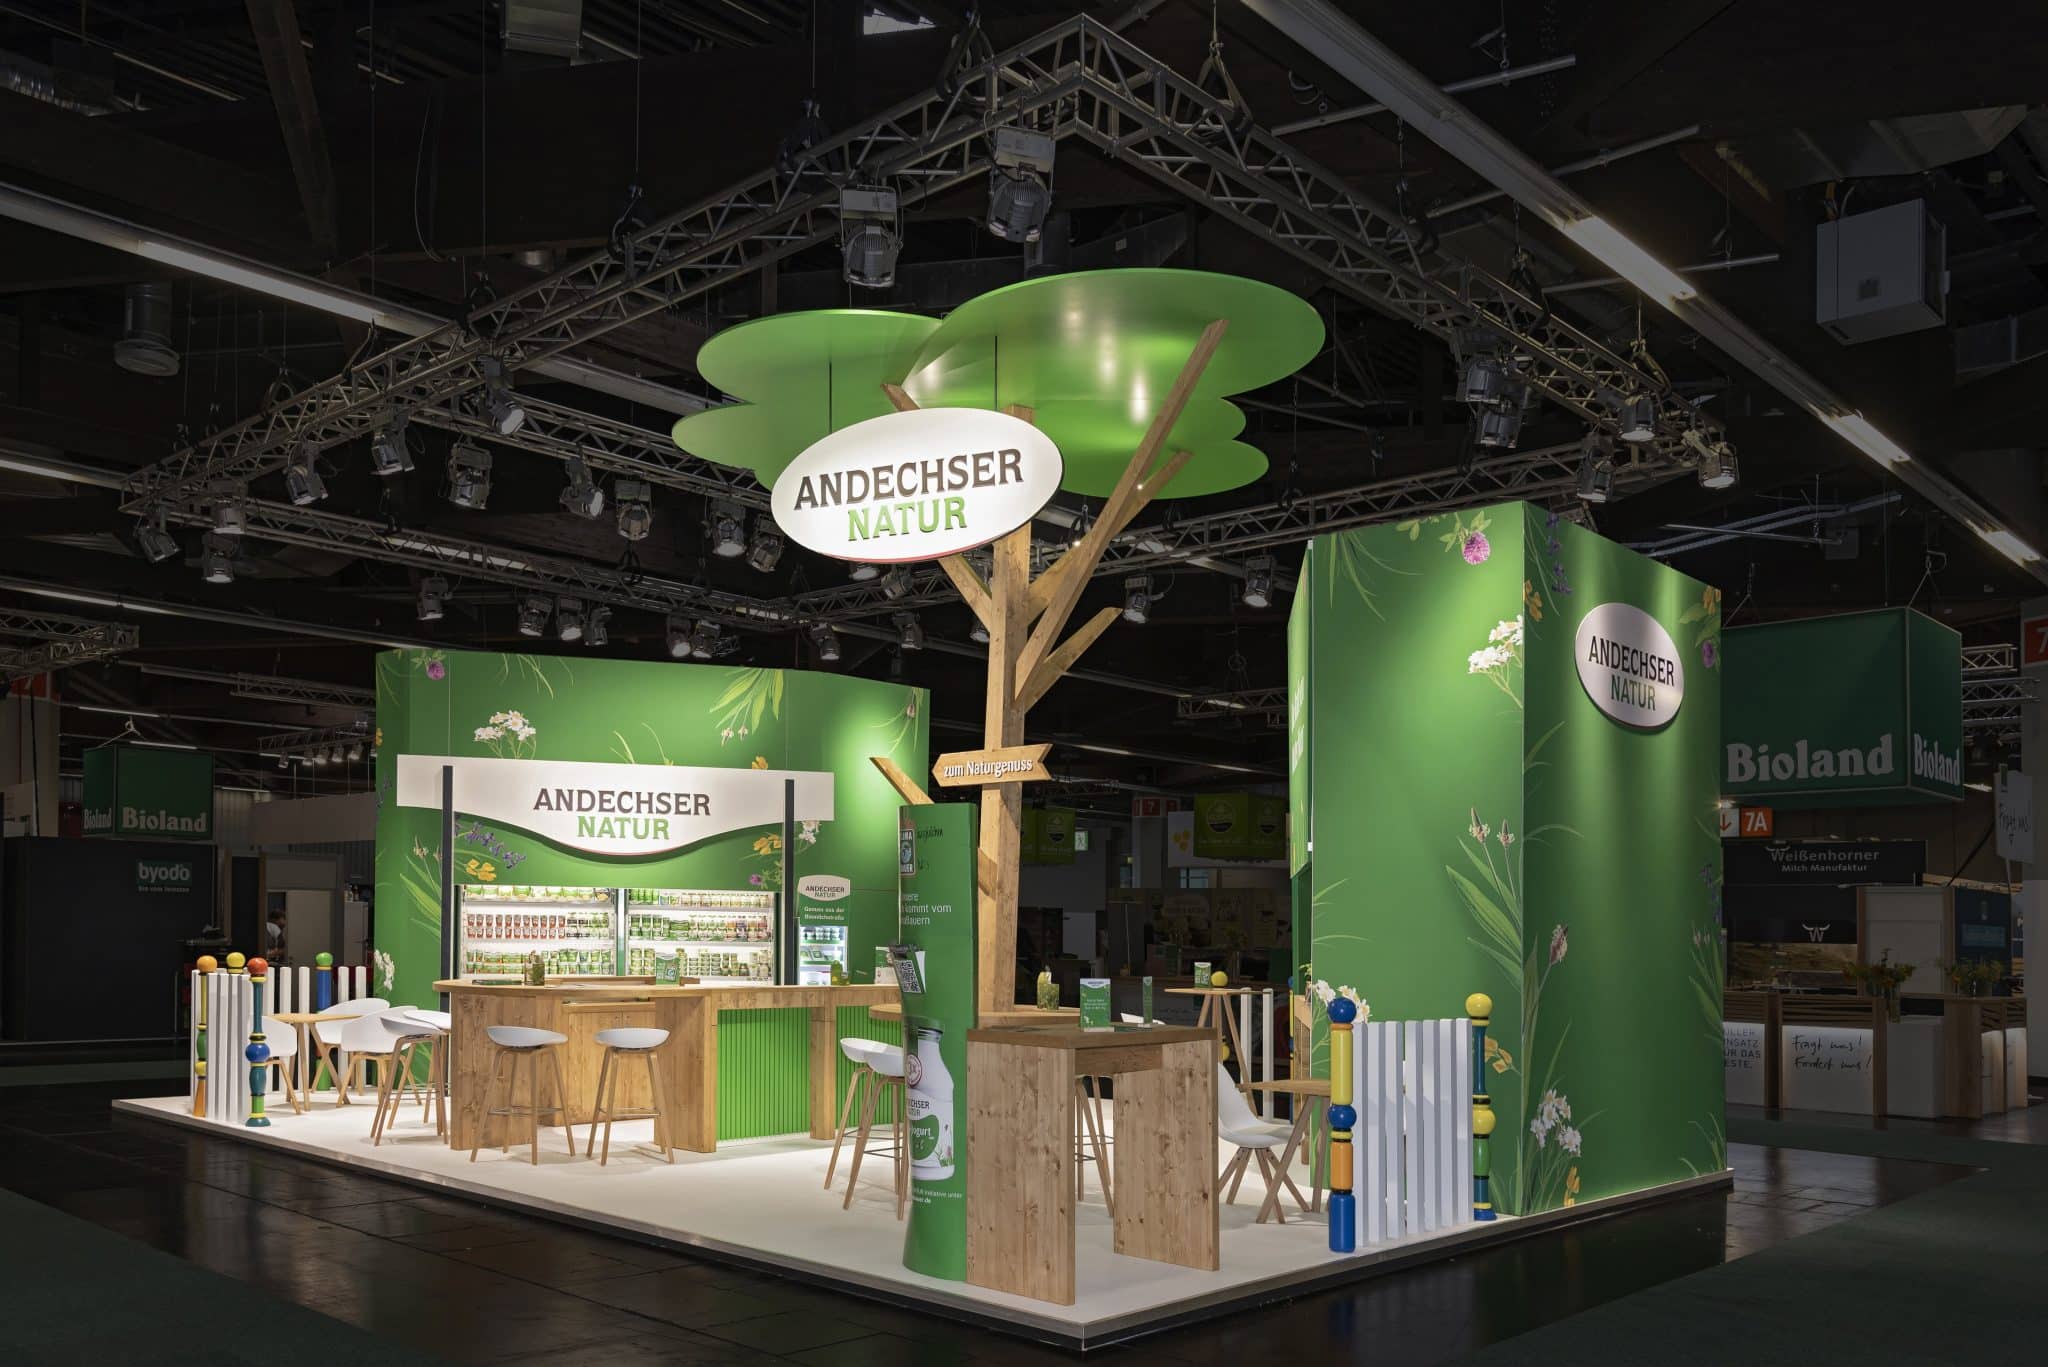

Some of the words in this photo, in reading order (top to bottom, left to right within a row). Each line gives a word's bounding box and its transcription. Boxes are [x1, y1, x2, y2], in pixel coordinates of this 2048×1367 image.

[794, 449, 1024, 510] ANDECHSER
[848, 497, 967, 542] NATUR
[1589, 636, 1674, 686] ANDECHSER
[1611, 675, 1656, 711] NATUR
[944, 765, 964, 777] zum
[967, 760, 1033, 778] Naturgenuss
[1726, 733, 1894, 783] Bioland
[1914, 733, 1960, 786] Bioland
[533, 788, 711, 816] ANDECHSER
[83, 807, 113, 829] Bioland
[122, 807, 208, 832] Bioland
[578, 816, 669, 840] NATUR
[1745, 811, 1767, 832] 7A
[1771, 849, 1880, 862] Weißenhorner
[138, 861, 191, 883] byodo
[1781, 863, 1808, 872] Milch
[1810, 863, 1868, 872] Manufaktur
[931, 905, 952, 913] vom
[1723, 1027, 1755, 1037] OLLER
[1723, 1038, 1759, 1048] INSATZ
[1741, 1049, 1761, 1058] DAS
[1792, 1035, 1823, 1055] Fragt
[1795, 1056, 1833, 1071] Fordert
